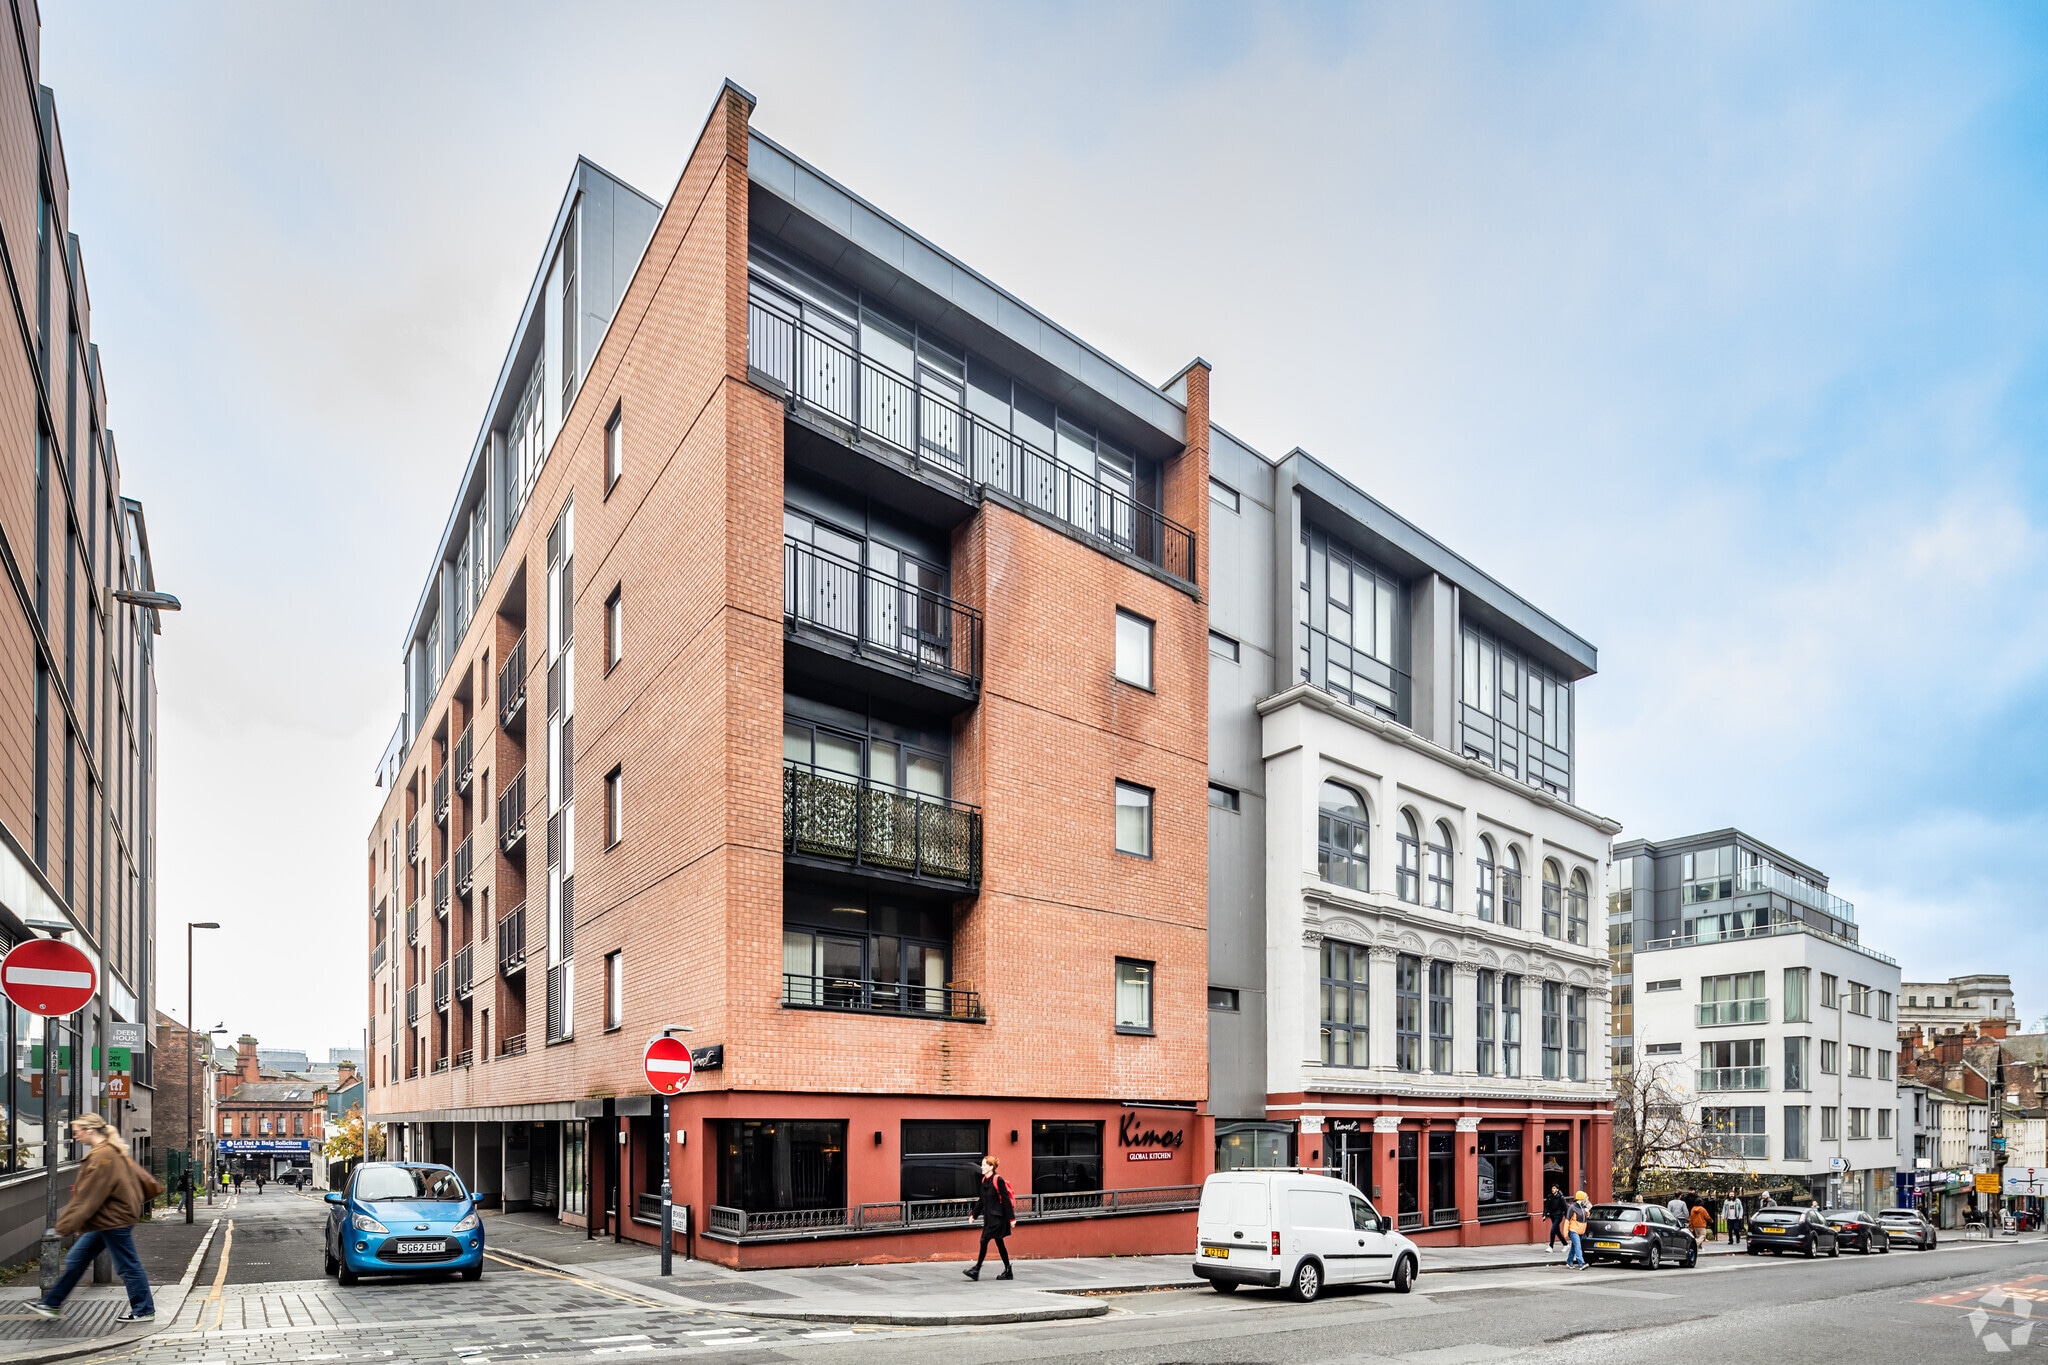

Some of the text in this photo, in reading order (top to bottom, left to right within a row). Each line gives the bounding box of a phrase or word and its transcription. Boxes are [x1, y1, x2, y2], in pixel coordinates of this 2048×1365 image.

[1118, 1111, 1184, 1148] Kimos
[1149, 1152, 1172, 1160] KITCHEN
[402, 1243, 442, 1252] SG62 ECT
